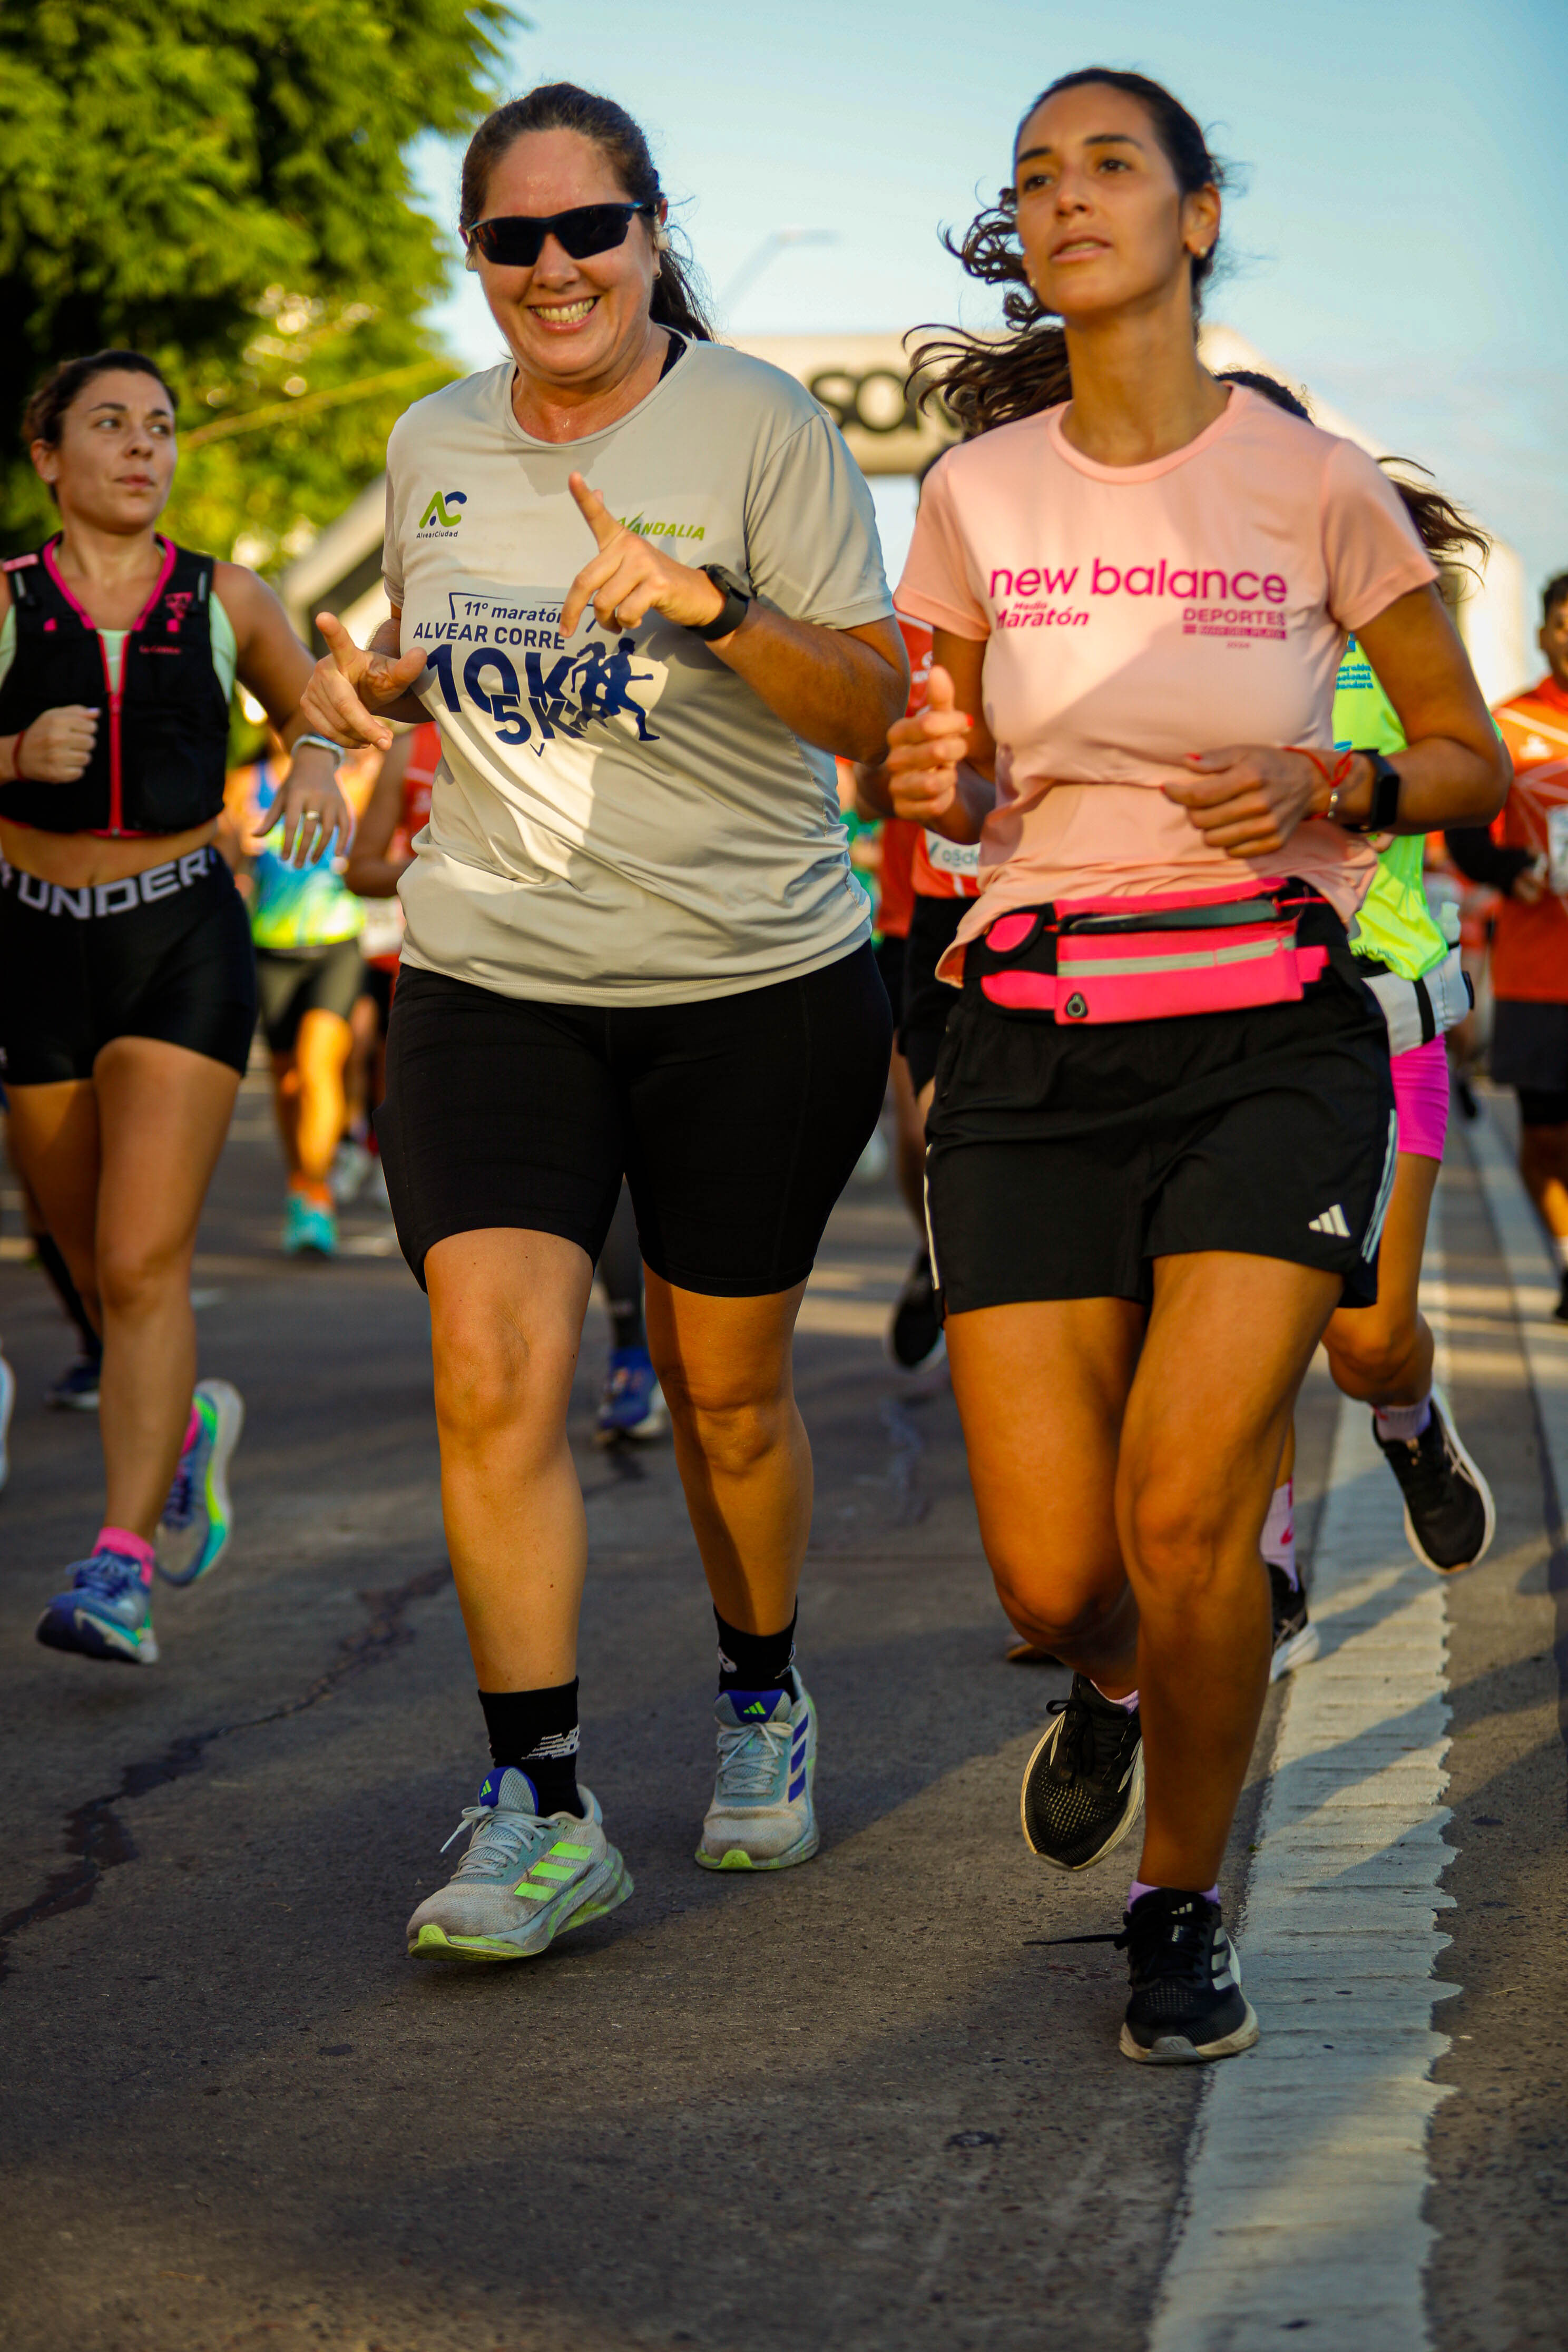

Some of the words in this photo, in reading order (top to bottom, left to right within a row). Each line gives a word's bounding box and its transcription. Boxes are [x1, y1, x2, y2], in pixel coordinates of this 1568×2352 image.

[988, 566, 1079, 599] new
[1090, 557, 1288, 604] balance
[413, 622, 488, 643] ALVEAR
[494, 627, 565, 650] CORRE
[17, 846, 210, 920] UNDER
